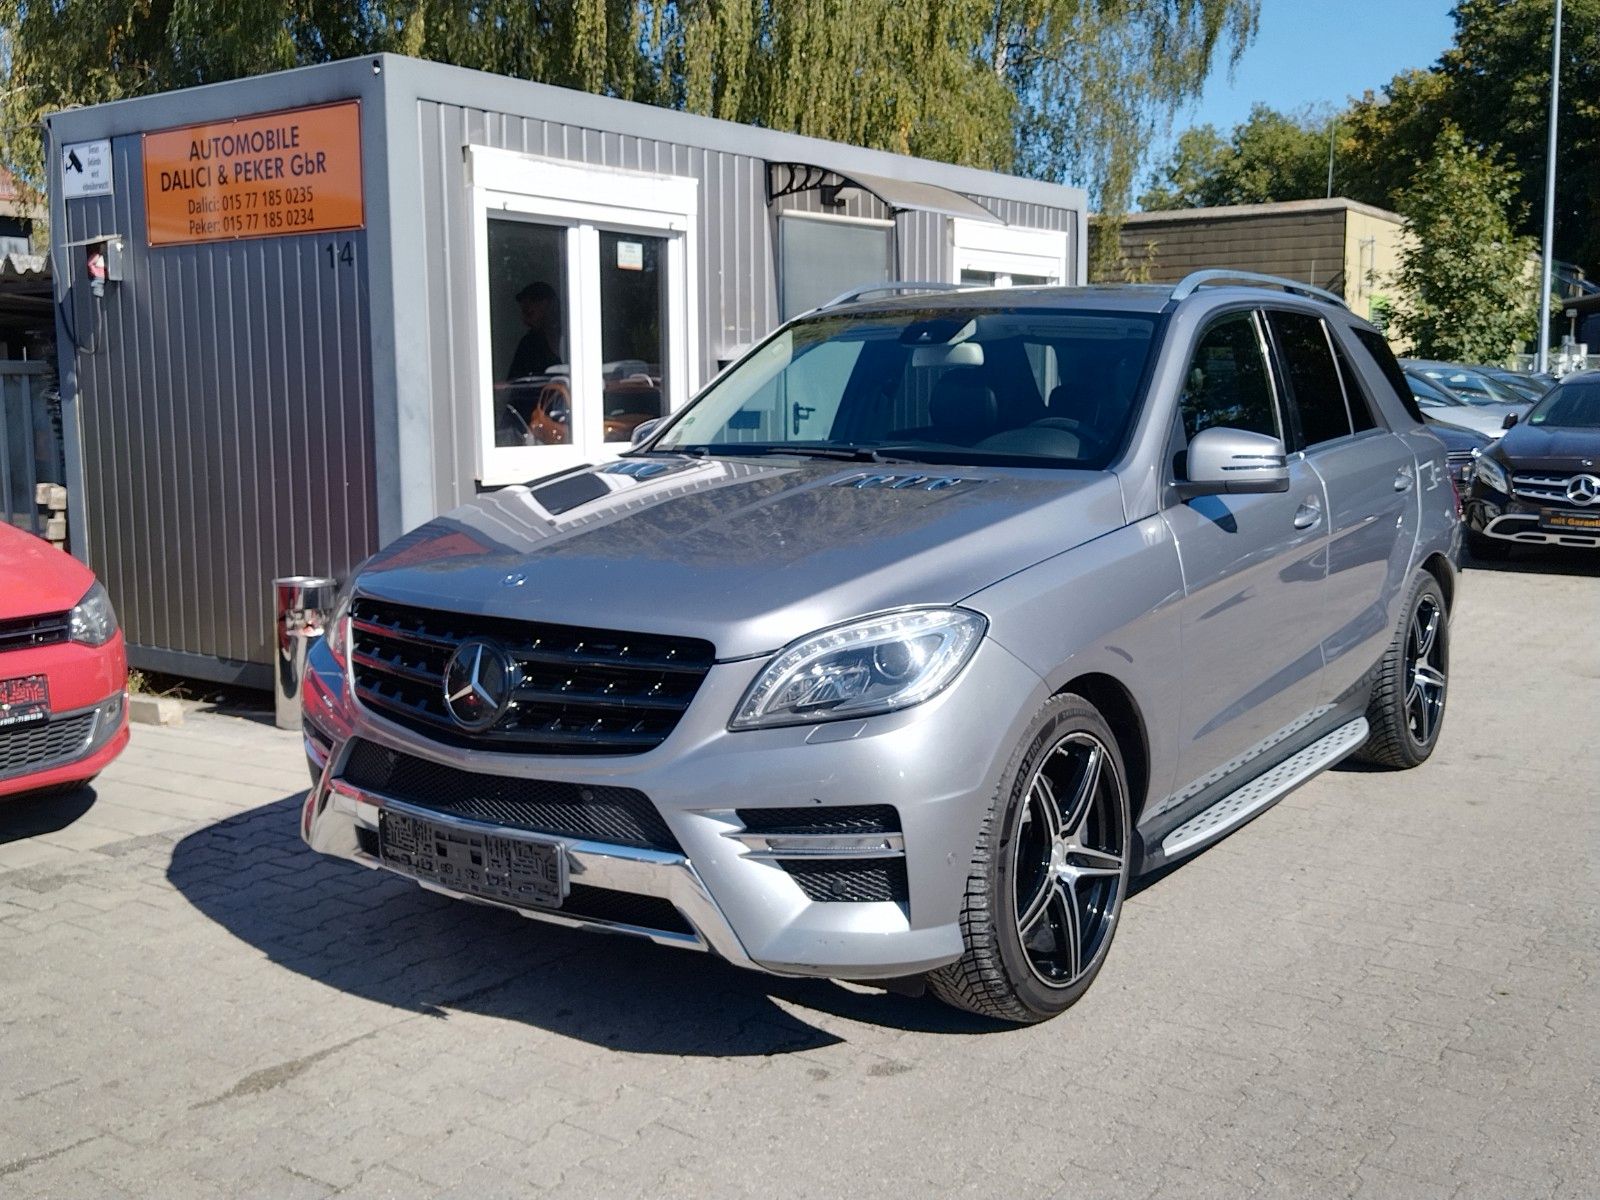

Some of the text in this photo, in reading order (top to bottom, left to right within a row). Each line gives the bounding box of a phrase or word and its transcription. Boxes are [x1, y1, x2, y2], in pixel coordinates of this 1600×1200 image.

[189, 126, 300, 162] AUTOMOBILE
[160, 151, 327, 192] DALICI & PEKER GbR
[188, 186, 313, 214] Dalici: 015 77 185 0235
[189, 208, 315, 235] Peker: 015 77 185 0234
[326, 241, 354, 269] 14
